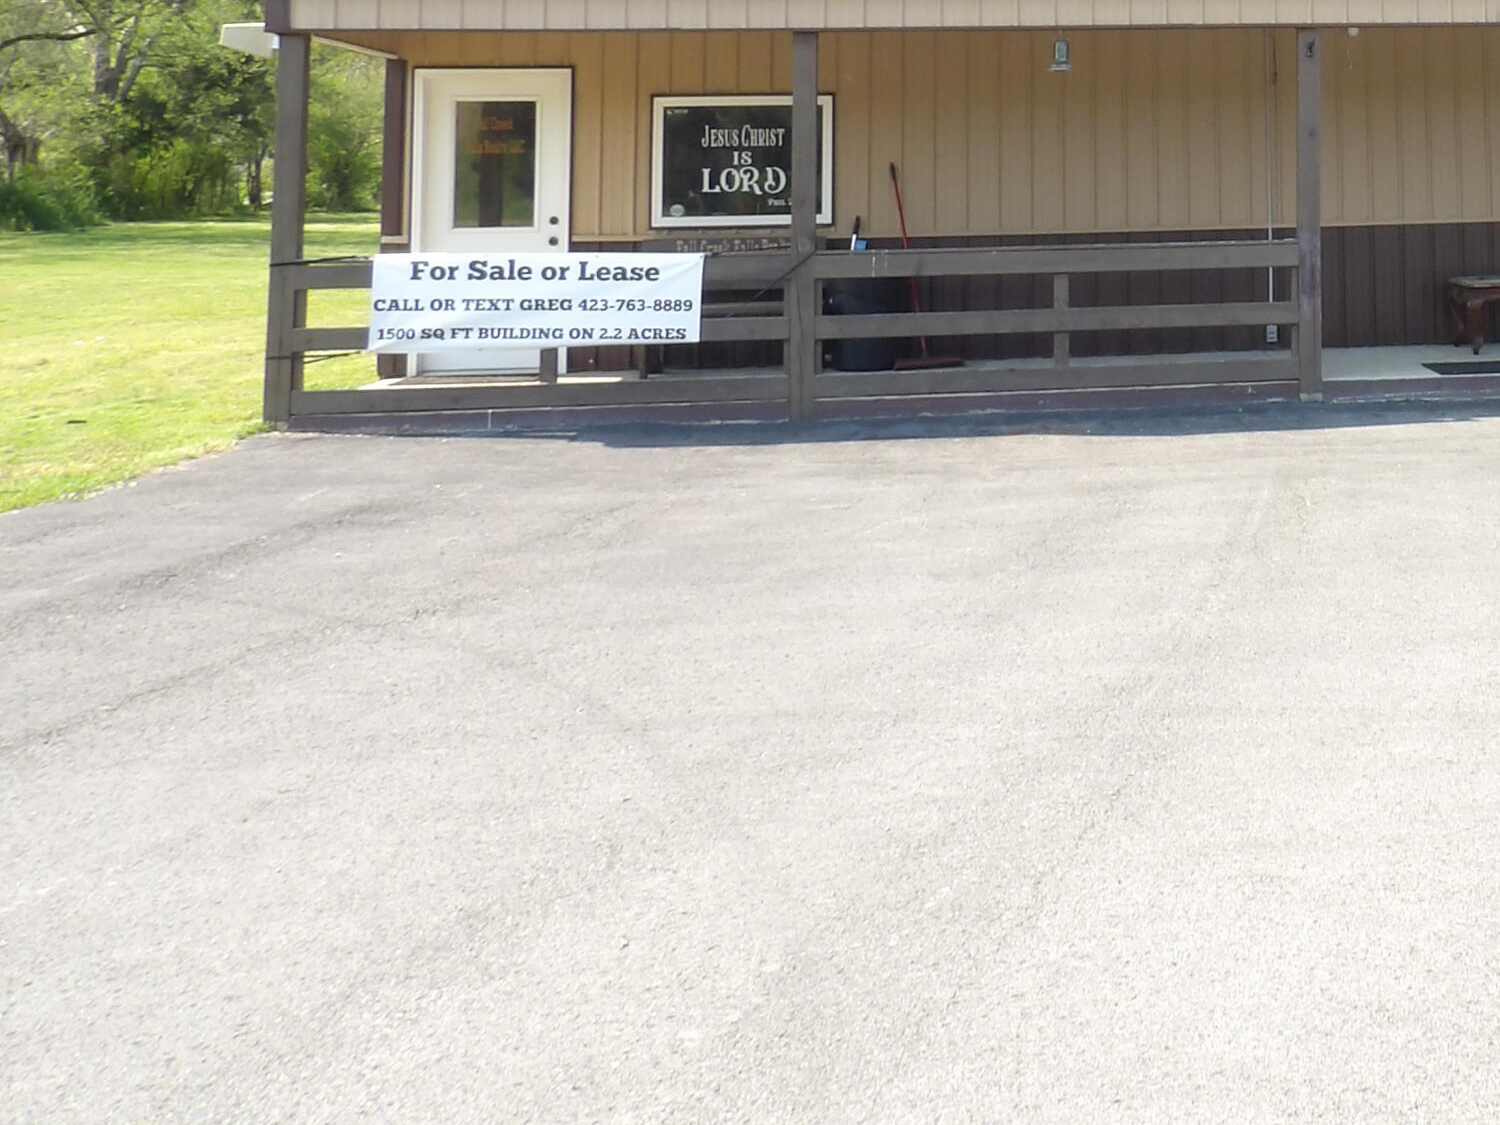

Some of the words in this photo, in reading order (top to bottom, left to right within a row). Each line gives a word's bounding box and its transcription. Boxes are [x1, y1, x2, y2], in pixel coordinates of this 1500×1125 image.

[701, 125, 740, 148] JESUS
[741, 124, 786, 148] CHRIST
[732, 151, 753, 166] IS
[701, 166, 787, 195] LORD
[410, 261, 459, 281] For
[467, 259, 532, 281] Sale
[541, 264, 570, 281] or
[578, 261, 661, 282] Lease
[373, 299, 424, 312] CALL
[430, 299, 456, 312] OR
[462, 299, 515, 312] TEXT
[519, 298, 573, 312] GREG
[577, 298, 694, 312] 423-763-8889
[377, 328, 416, 341] 1500
[420, 327, 446, 341] SQ
[450, 327, 474, 340] FT
[477, 327, 564, 340] BUILDING
[568, 327, 595, 340] ON
[598, 328, 623, 340] 2.2
[627, 327, 687, 340] ACRES
